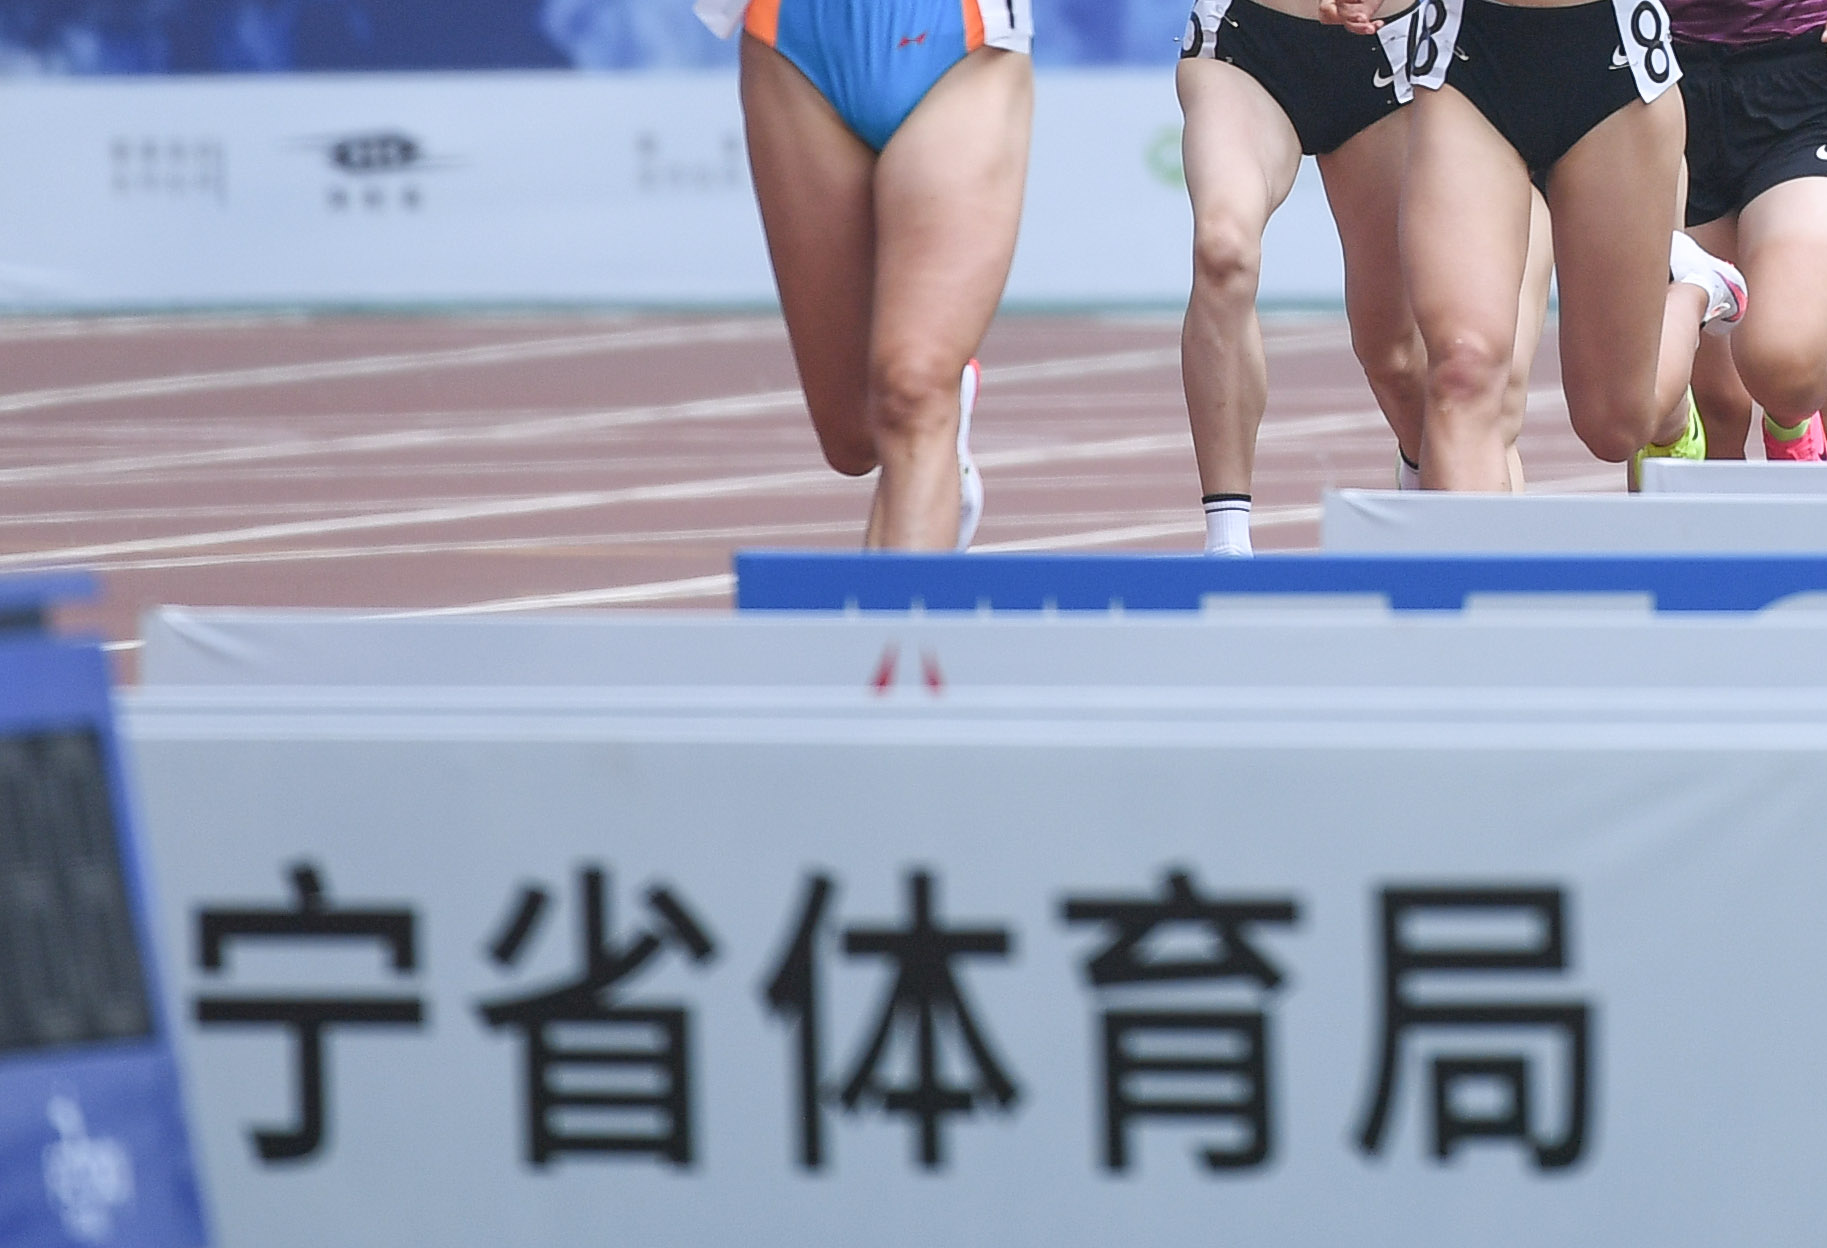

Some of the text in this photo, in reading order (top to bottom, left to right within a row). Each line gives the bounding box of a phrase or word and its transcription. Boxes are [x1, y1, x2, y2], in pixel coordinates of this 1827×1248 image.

[1630, 0, 1670, 84] 8
[190, 862, 1602, 1176] 宁省体育局
